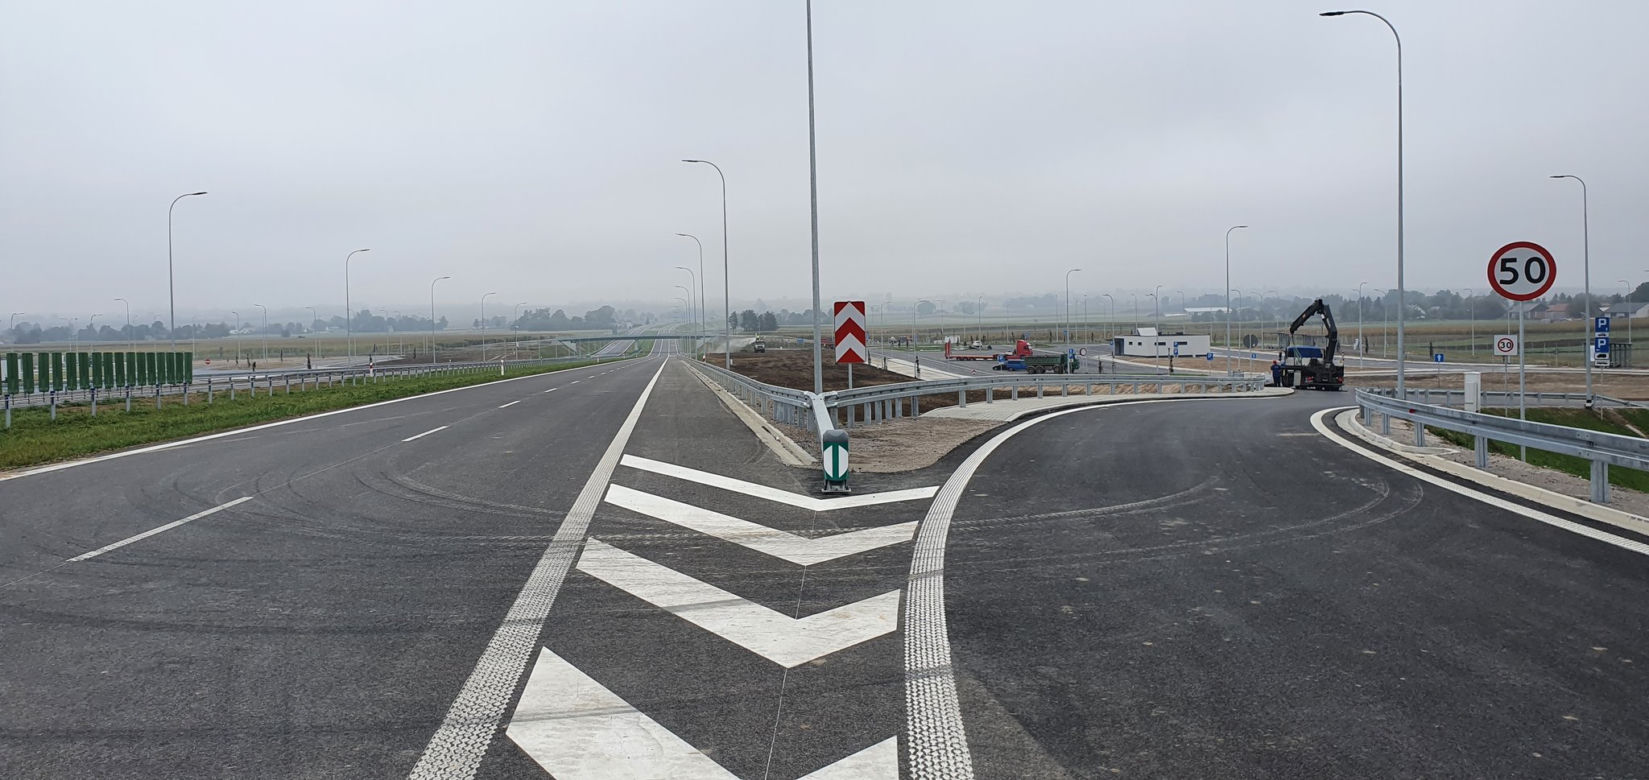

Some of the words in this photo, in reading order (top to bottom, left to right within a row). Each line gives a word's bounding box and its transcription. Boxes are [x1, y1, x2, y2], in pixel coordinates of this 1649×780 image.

[1499, 256, 1546, 285] 50
[1598, 318, 1607, 328] P
[1500, 341, 1512, 349] 30
[1598, 338, 1607, 348] P
